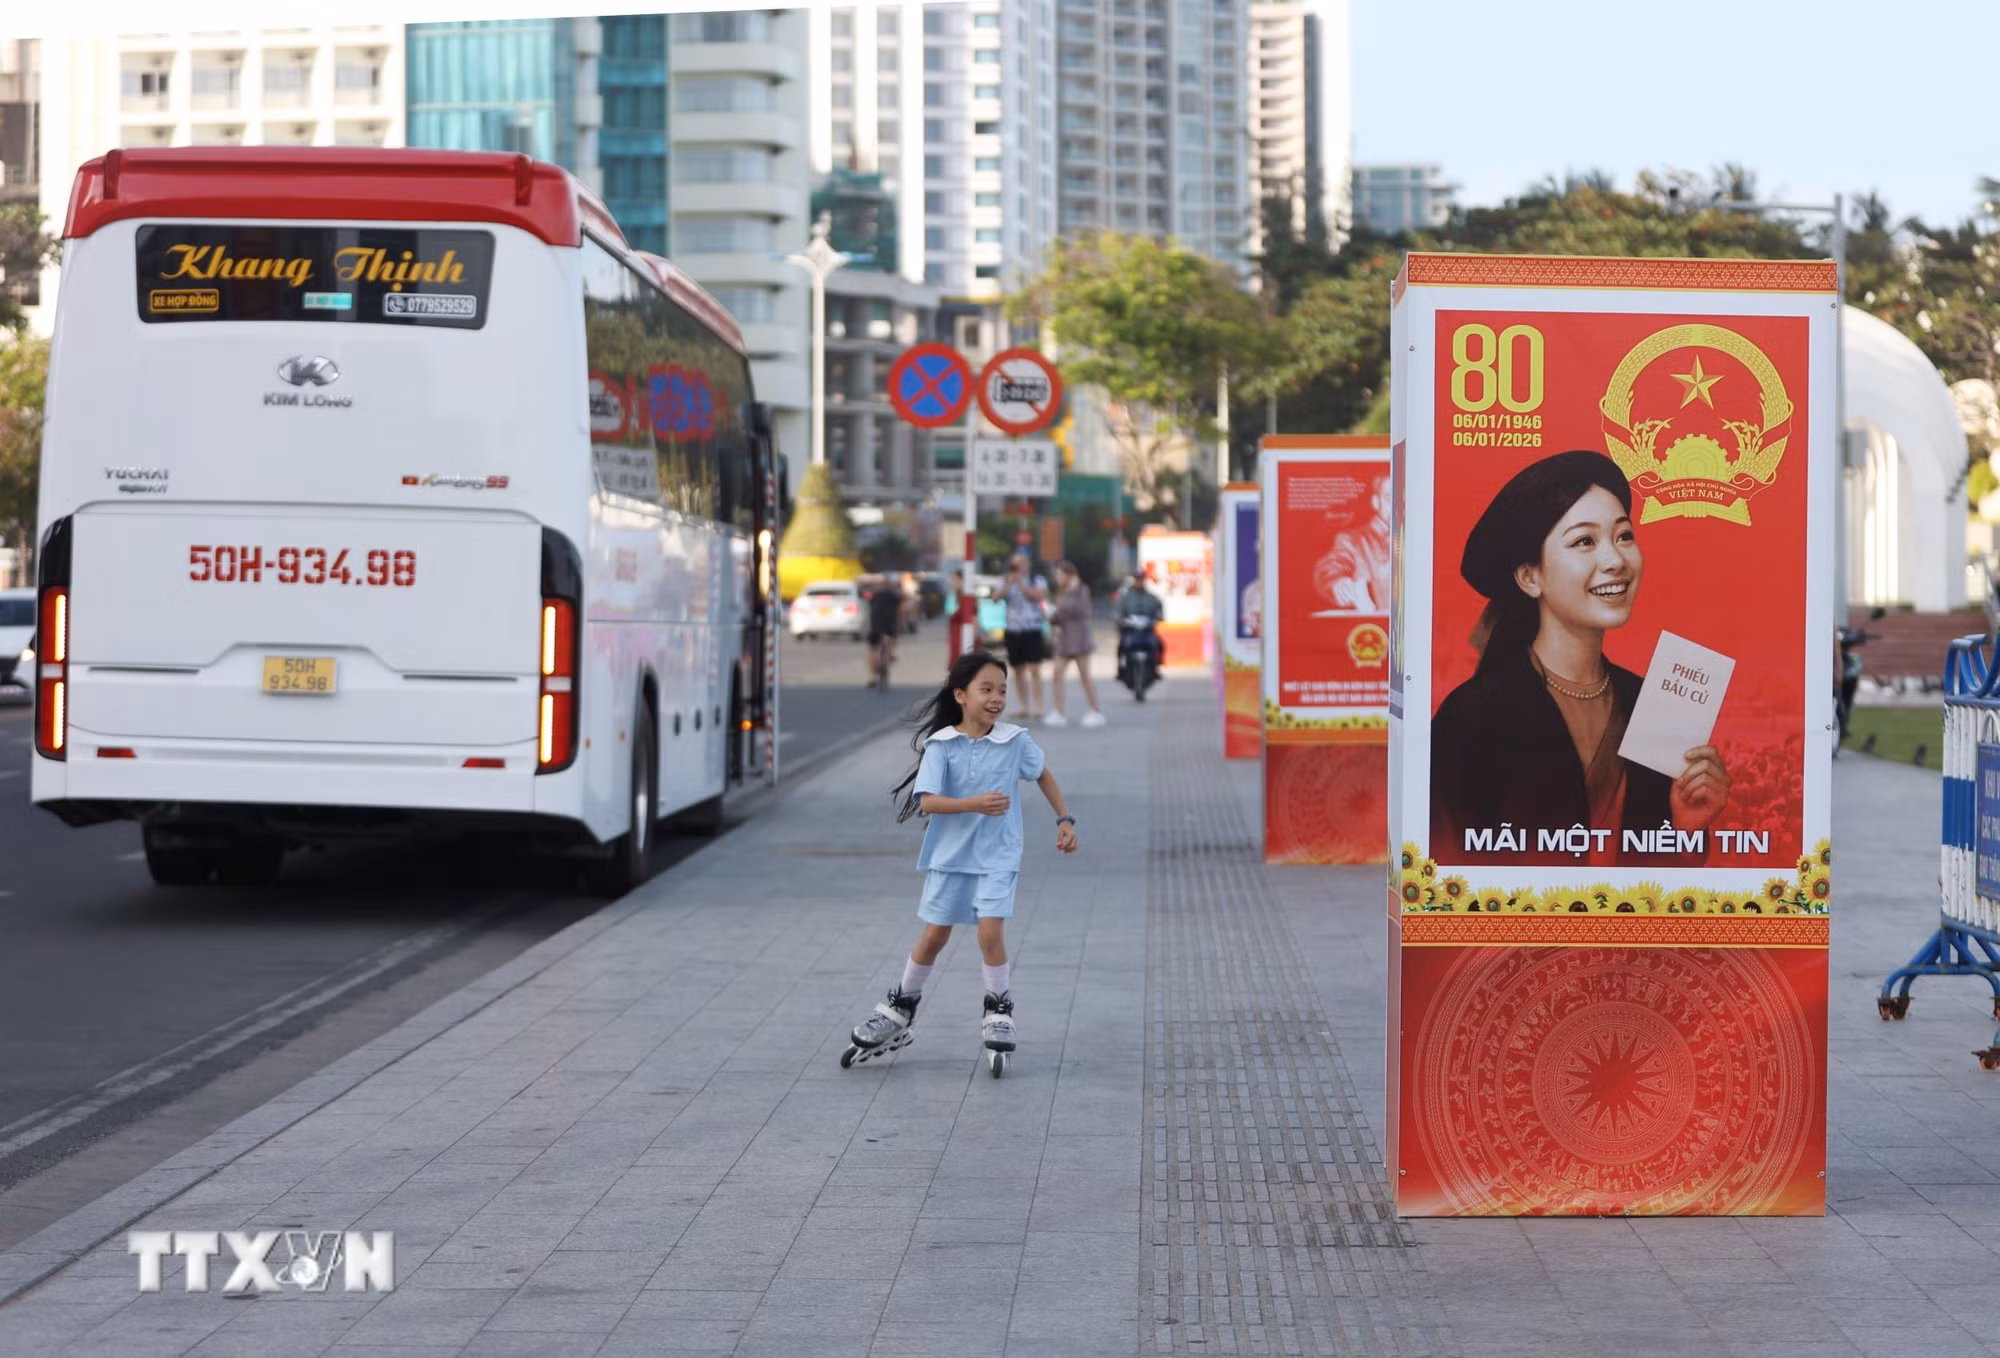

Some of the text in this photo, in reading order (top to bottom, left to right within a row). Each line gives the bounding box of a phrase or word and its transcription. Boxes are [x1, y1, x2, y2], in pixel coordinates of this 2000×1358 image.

[160, 244, 466, 292] Khang Thịnh
[154, 295, 166, 307] XE
[407, 297, 474, 313] 0779529529
[1451, 323, 1544, 413] 80
[263, 392, 352, 408] KIM LONG
[1452, 413, 1543, 429] 06/01/1946
[1452, 431, 1543, 447] 06/01/2026
[1668, 487, 1724, 500] VIỆT NAM
[189, 544, 417, 587] 50H-934.98
[284, 657, 316, 674] 50H
[1671, 663, 1710, 686] PHIẾU
[1660, 678, 1710, 705] BẦU CỬ
[1464, 819, 1769, 858] MÃI MỘT NIỀM TIN
